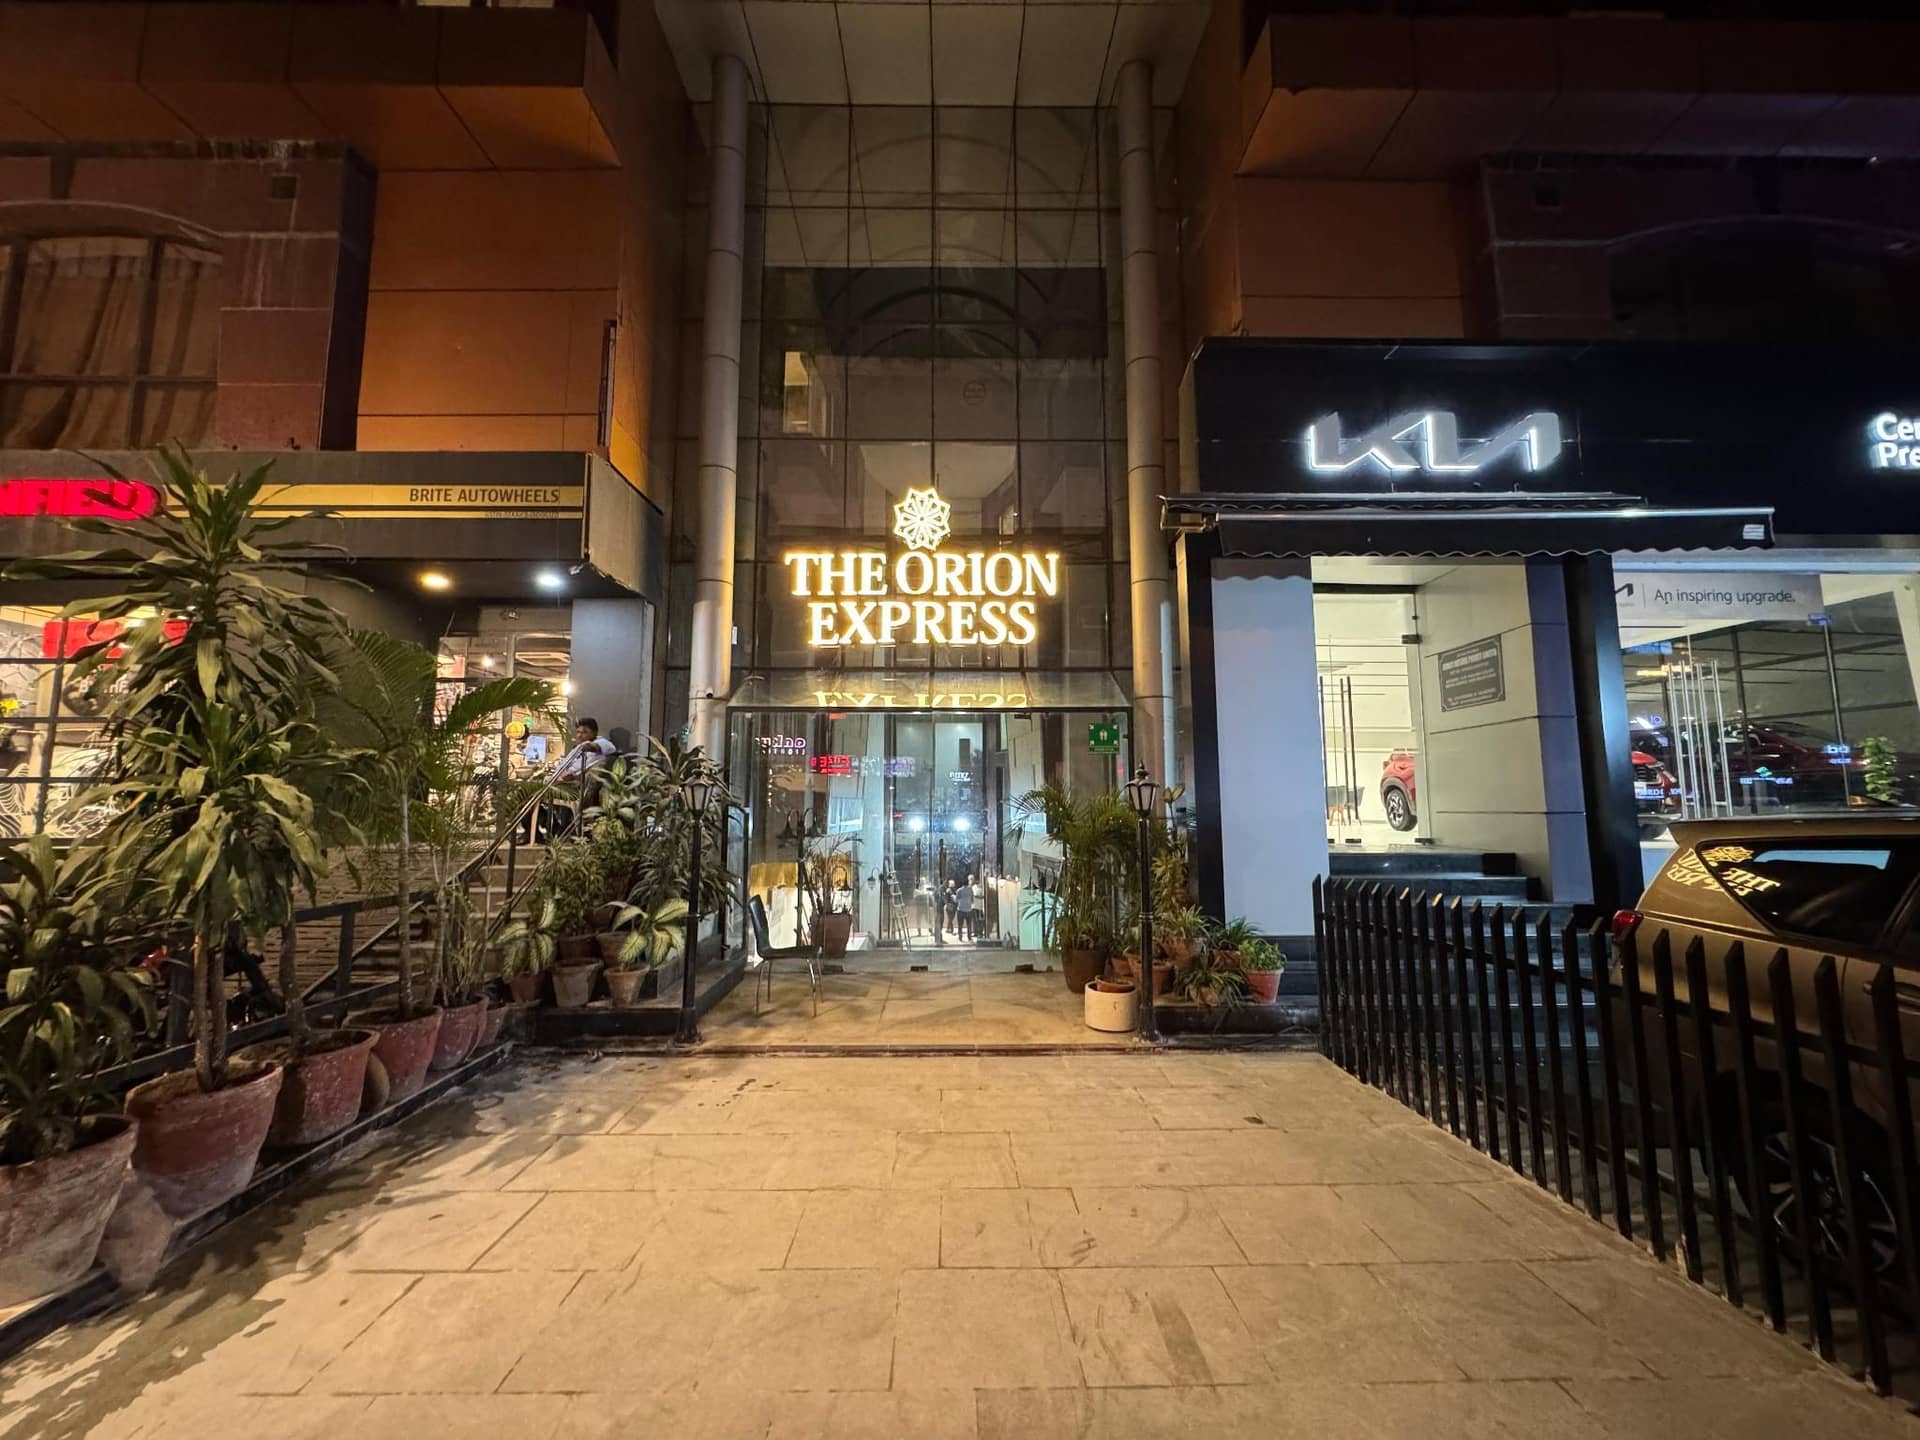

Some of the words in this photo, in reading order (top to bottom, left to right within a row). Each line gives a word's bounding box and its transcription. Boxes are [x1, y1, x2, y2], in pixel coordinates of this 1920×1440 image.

[1306, 411, 1560, 471] KIA
[409, 488, 452, 502] BRITE
[457, 488, 560, 503] AUTOWHEELS
[785, 553, 887, 596] THE
[896, 551, 1060, 596] ORION
[1655, 589, 1673, 604] An
[1677, 588, 1732, 605] inspiring
[808, 601, 1036, 645] EXPRESS
